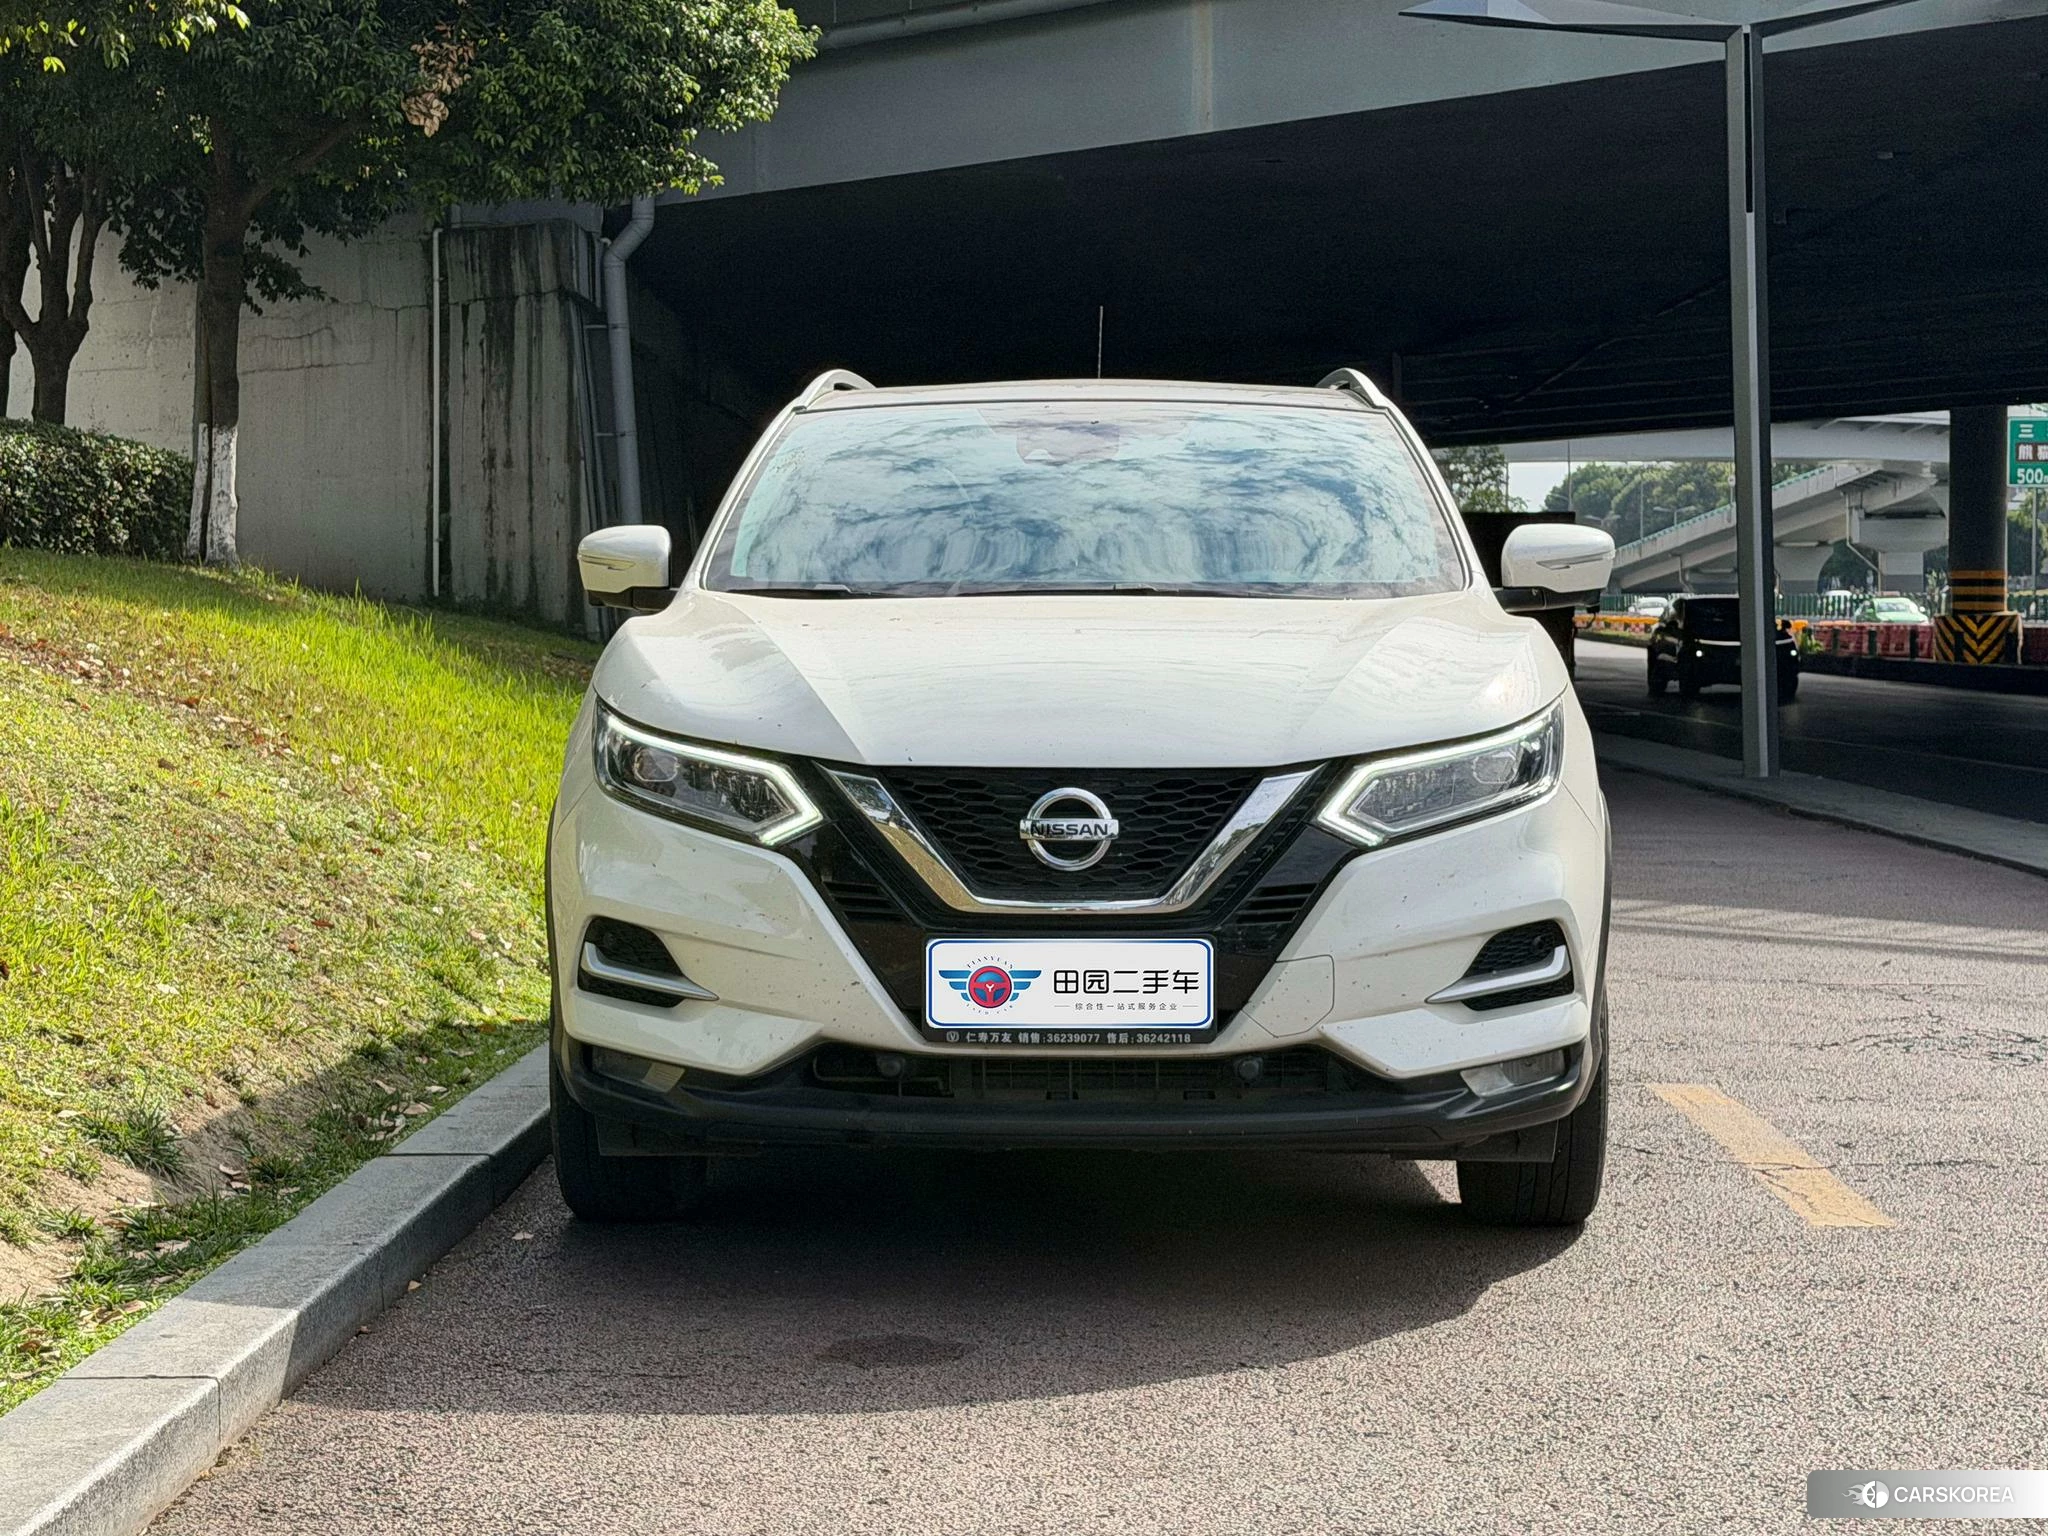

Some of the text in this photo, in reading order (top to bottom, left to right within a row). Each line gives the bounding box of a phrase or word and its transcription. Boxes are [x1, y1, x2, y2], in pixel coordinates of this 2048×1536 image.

[1030, 823, 1108, 836] NISSAN
[1053, 969, 1199, 994] 田园二手车
[1075, 1002, 1178, 1011] 综合性一站式服务企业
